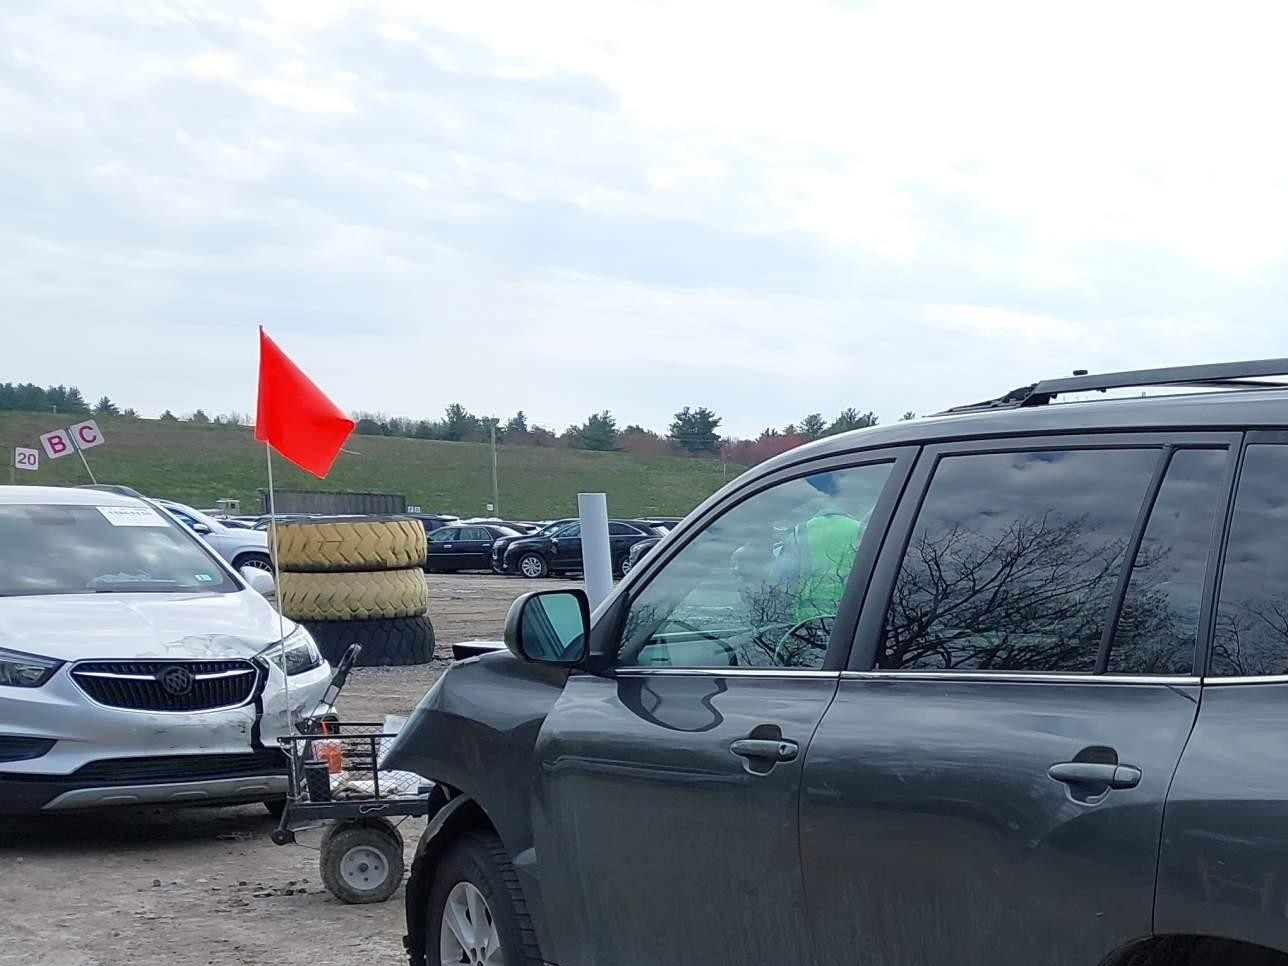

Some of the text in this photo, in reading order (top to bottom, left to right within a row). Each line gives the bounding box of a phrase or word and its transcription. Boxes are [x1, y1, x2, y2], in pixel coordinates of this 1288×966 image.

[47, 425, 97, 455] B C
[17, 452, 37, 466] 20
